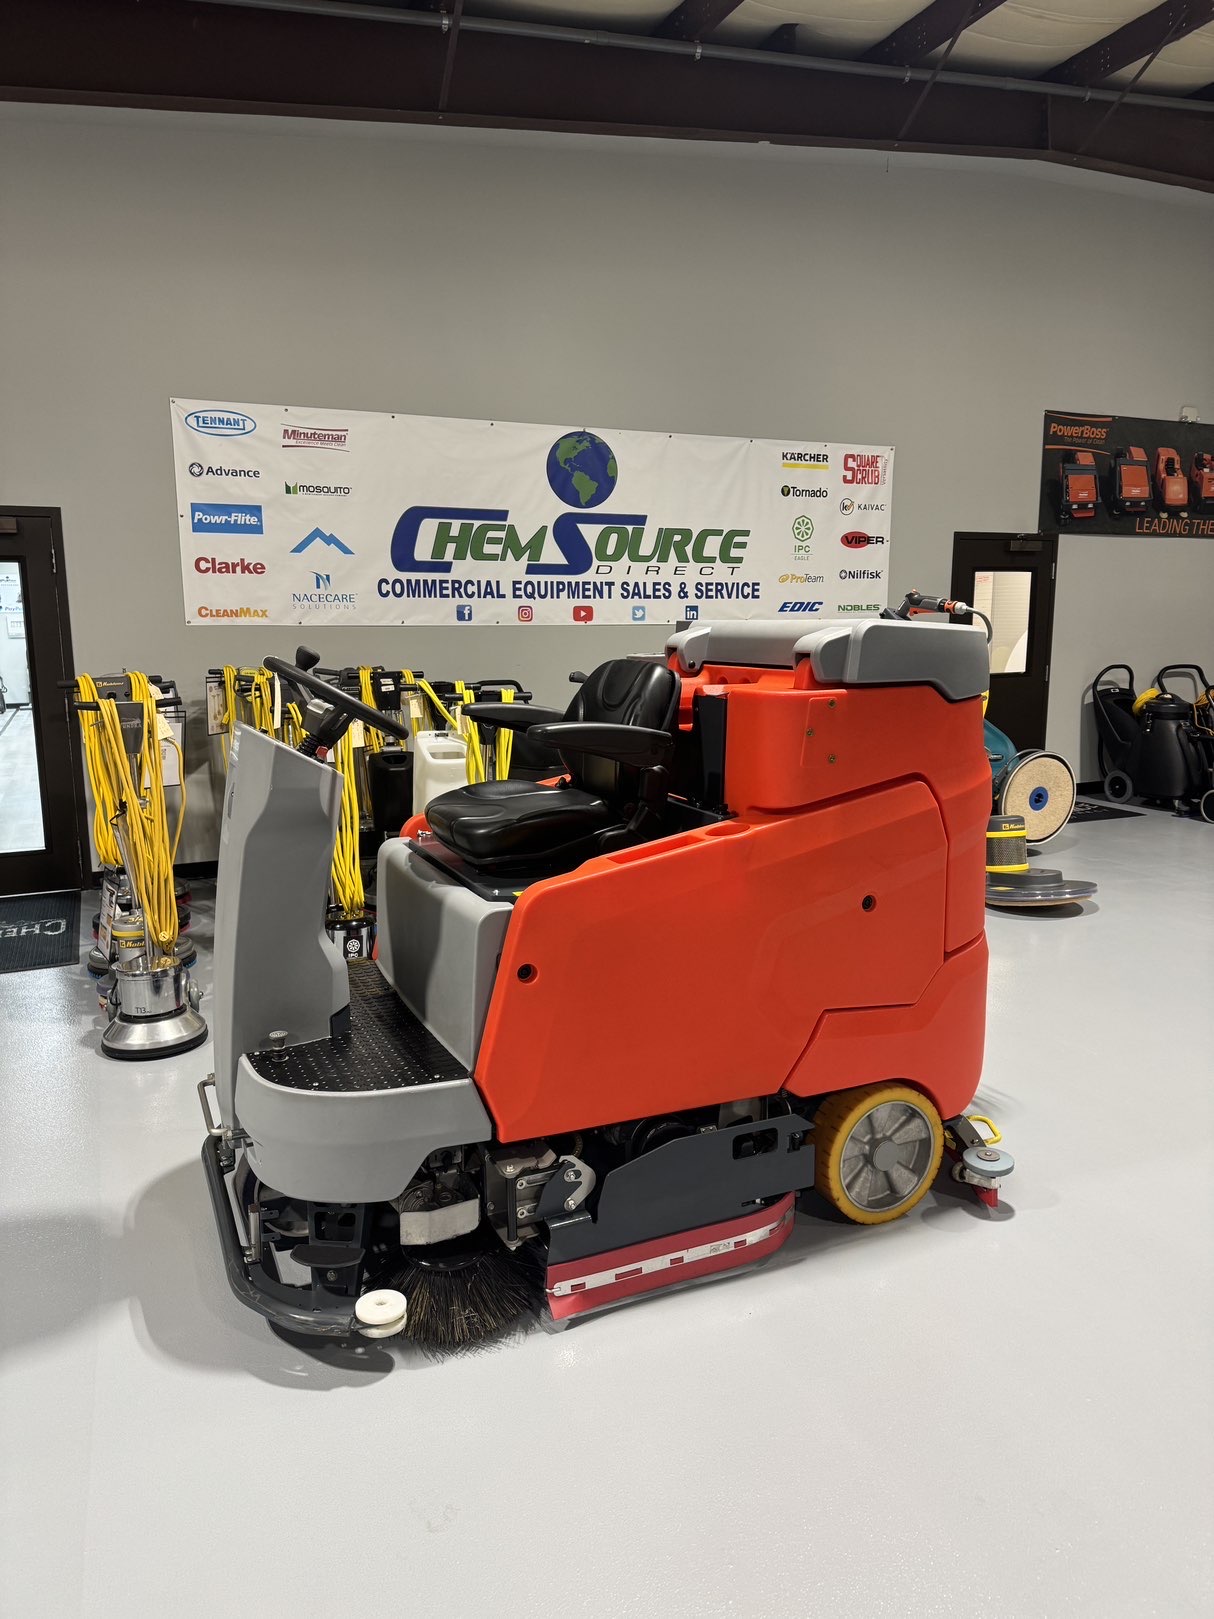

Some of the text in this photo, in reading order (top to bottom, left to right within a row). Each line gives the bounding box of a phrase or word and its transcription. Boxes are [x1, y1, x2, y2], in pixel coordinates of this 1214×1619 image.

[194, 415, 247, 430] TENNANT
[283, 429, 347, 443] Minuteman
[1050, 423, 1107, 439] PowerBoss
[782, 452, 829, 463] KÄRCHER
[206, 466, 260, 478] Advance
[791, 486, 828, 498] Tornado
[857, 503, 885, 511] KAIVAC
[194, 512, 260, 525] Powr-Flite
[1136, 518, 1190, 534] LEADING
[845, 536, 885, 545] VIPER
[794, 545, 811, 553] IPC
[194, 556, 266, 575] Clarke
[595, 565, 742, 576] DIRECT
[789, 573, 824, 583] ProTeam
[848, 570, 882, 579] Nilfisk
[377, 578, 760, 600] COMMERCIAL EQUIPMENT SALES & SERVICE
[292, 593, 356, 603] NACECARE
[778, 602, 823, 612] EDIC
[838, 604, 880, 612] NOBLES
